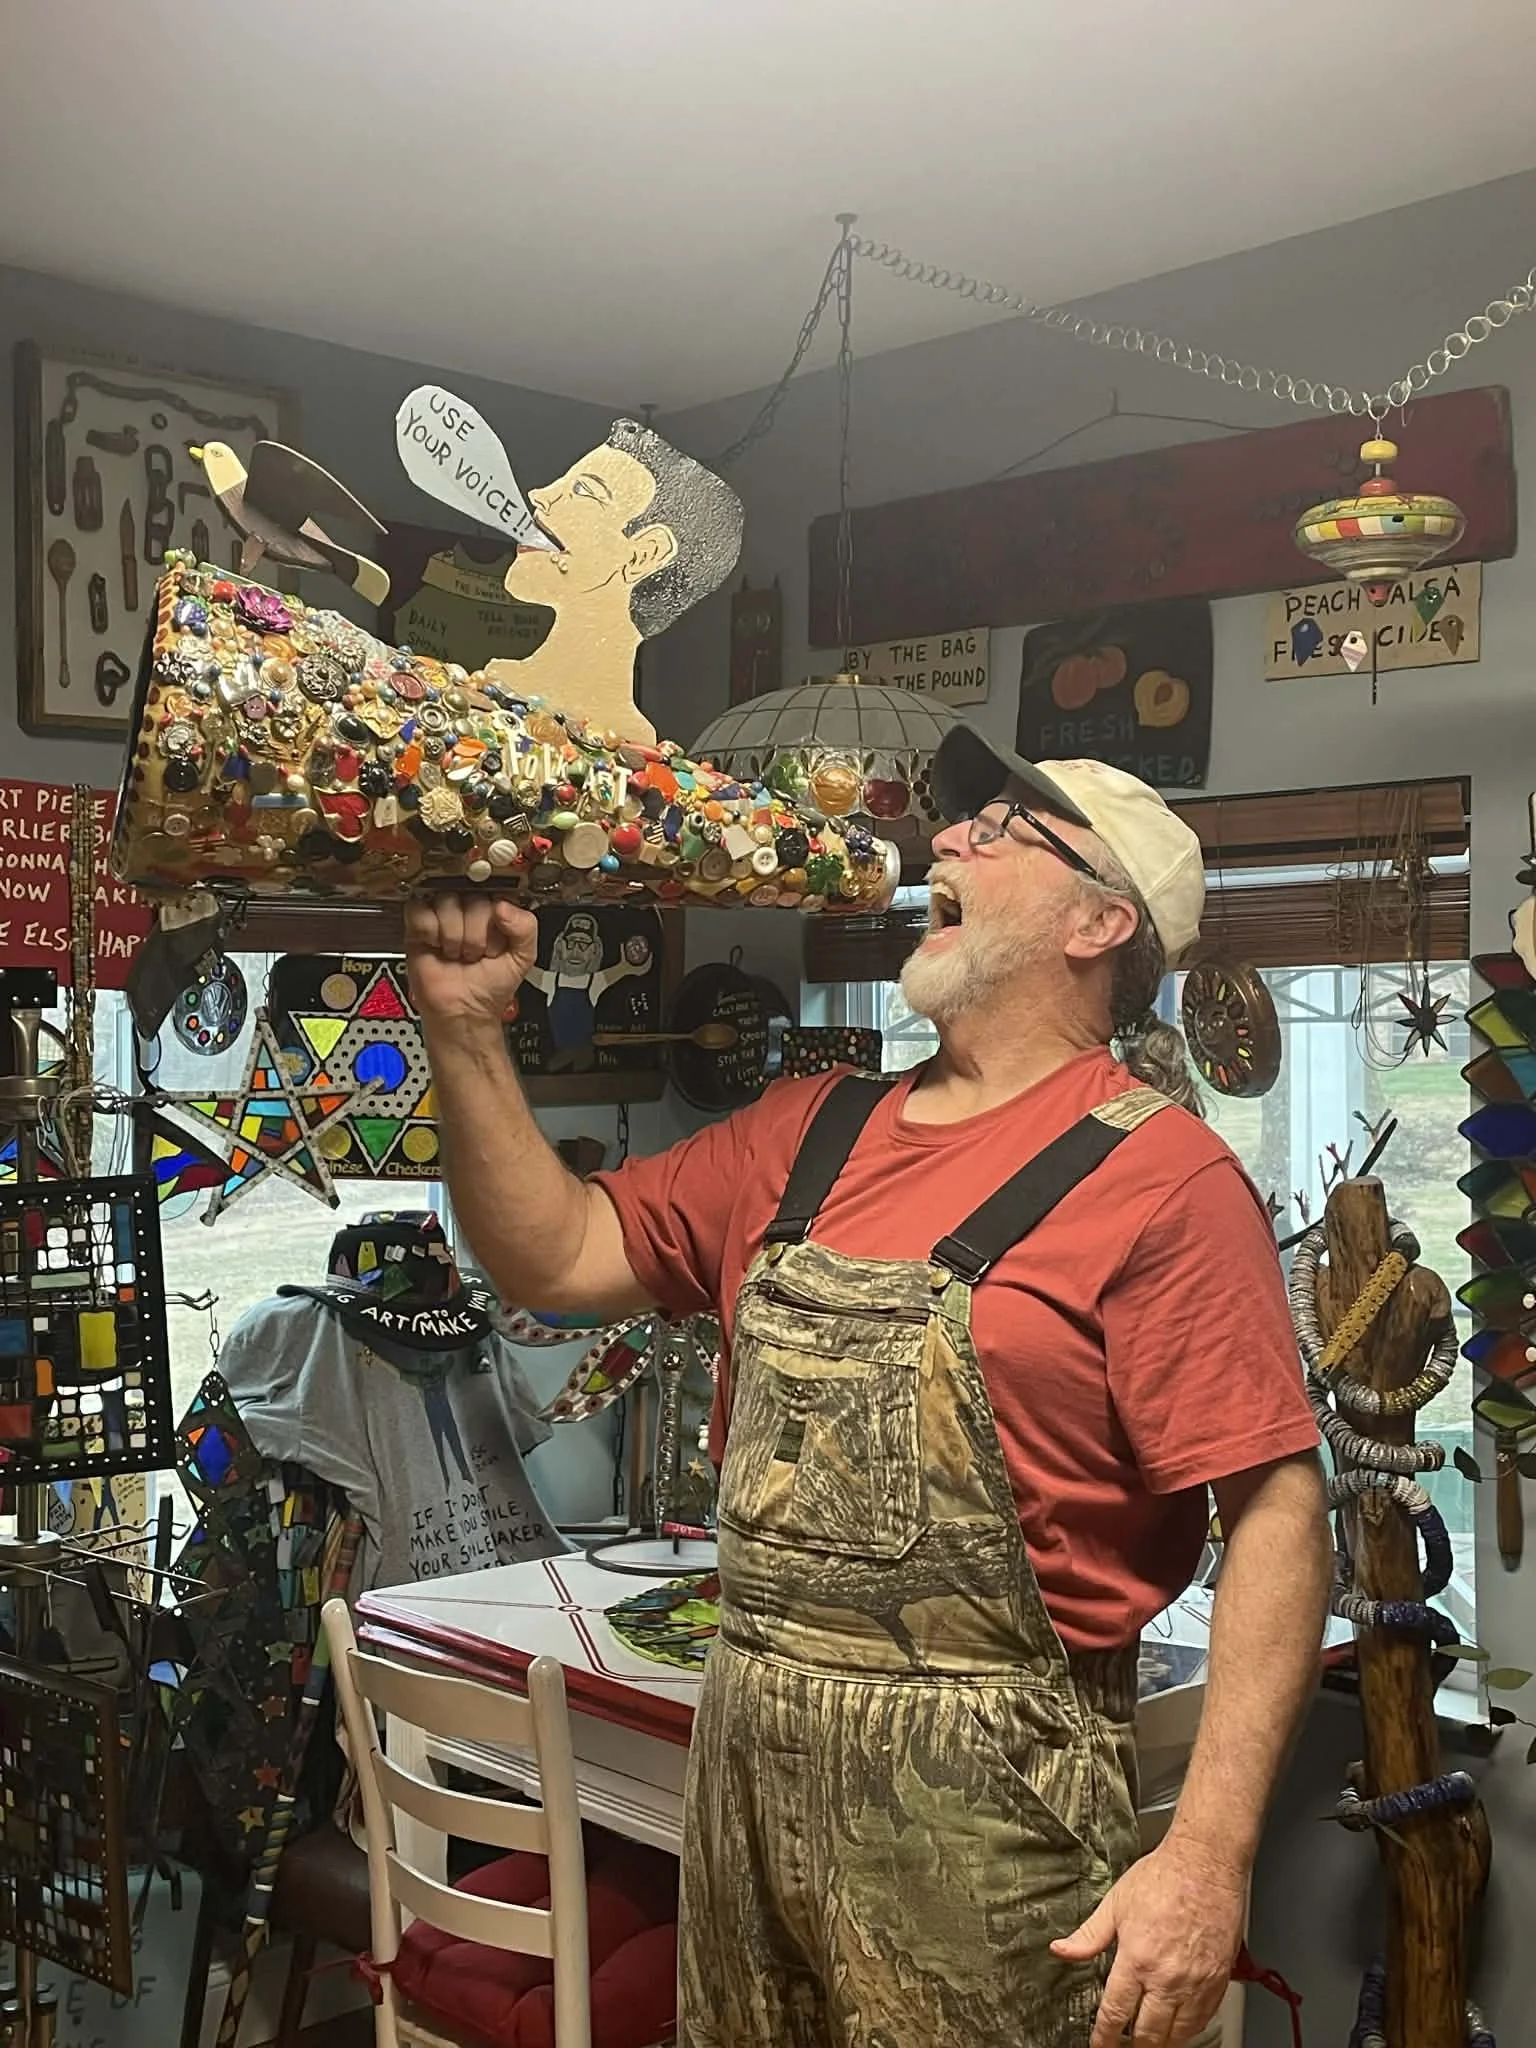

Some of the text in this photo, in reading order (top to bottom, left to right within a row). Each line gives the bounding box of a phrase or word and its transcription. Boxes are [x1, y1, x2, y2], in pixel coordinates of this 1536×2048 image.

[429, 393, 475, 441] USE
[403, 407, 451, 465] YOUR
[1285, 573, 1461, 622] PEACH ALA
[847, 636, 977, 671] BY THE BAG
[893, 672, 927, 692] THE
[931, 667, 986, 692] POUND
[1040, 713, 1135, 752] FRESH
[0, 852, 66, 875] ONNA
[24, 922, 73, 952] ELS
[341, 958, 373, 975] Hop
[360, 1306, 410, 1330] ART
[420, 1311, 479, 1337] MAKE
[432, 1309, 449, 1318] TO
[412, 1507, 433, 1530] IF
[410, 1523, 458, 1553] MAKE
[409, 1552, 452, 1581] YOUR
